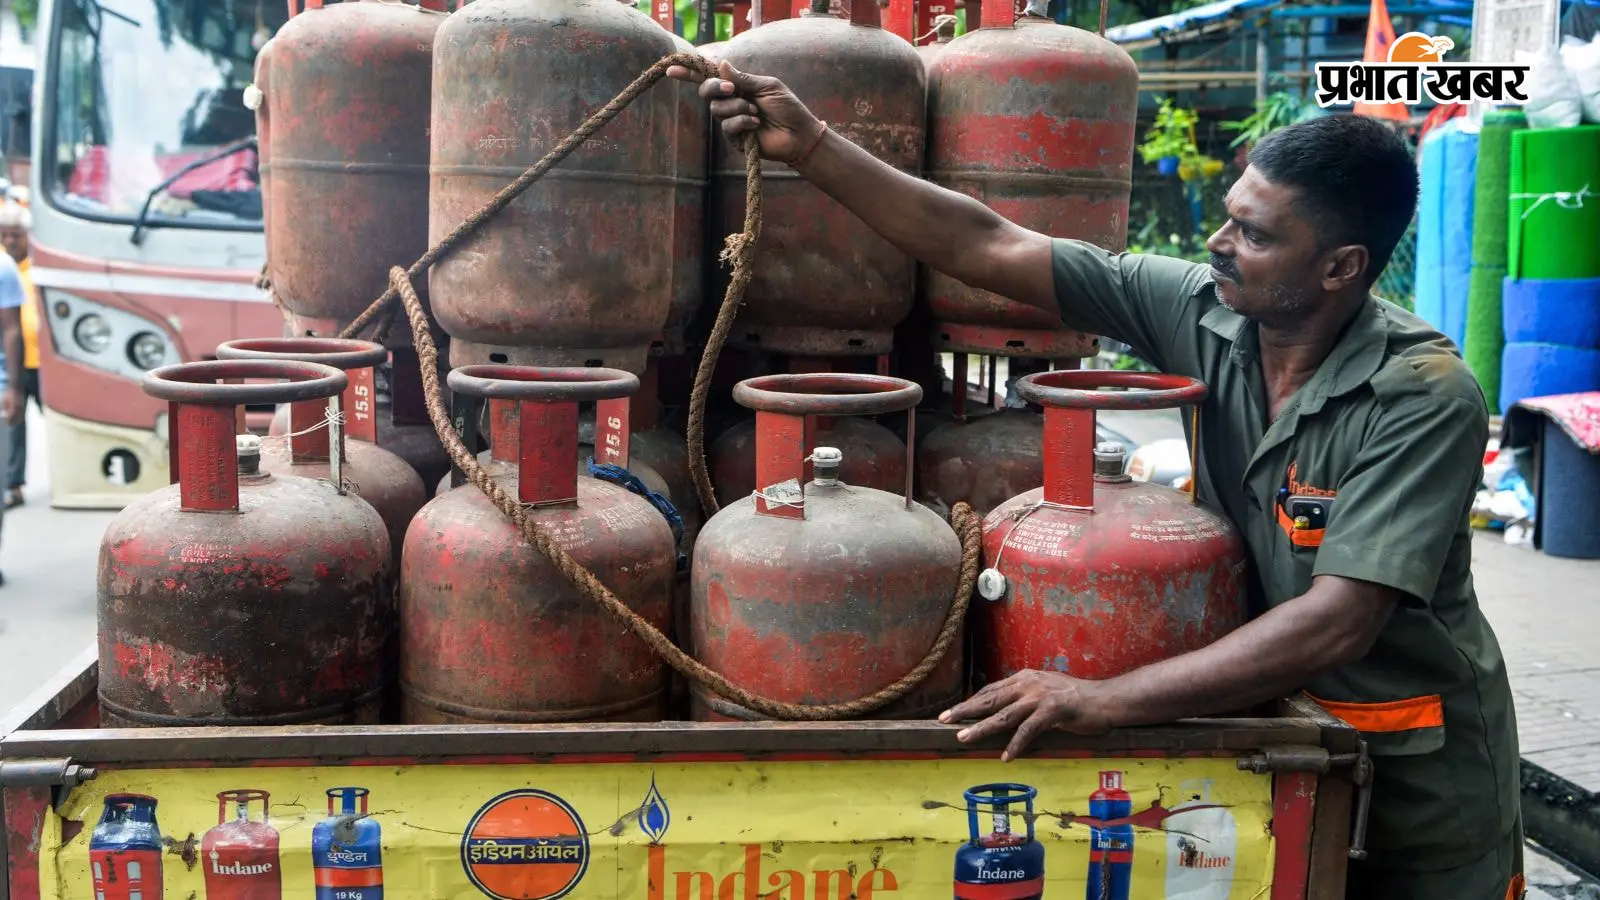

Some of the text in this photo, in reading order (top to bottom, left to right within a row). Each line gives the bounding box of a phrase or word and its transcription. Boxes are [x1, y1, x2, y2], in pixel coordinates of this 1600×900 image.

[355, 384, 368, 420] 15.5
[605, 416, 621, 457] 15.6
[470, 840, 525, 863] इंडियन
[212, 859, 272, 875] Indane
[643, 843, 898, 900] Indane
[977, 866, 1025, 880] Indane
[336, 891, 362, 900] 19 Kg
